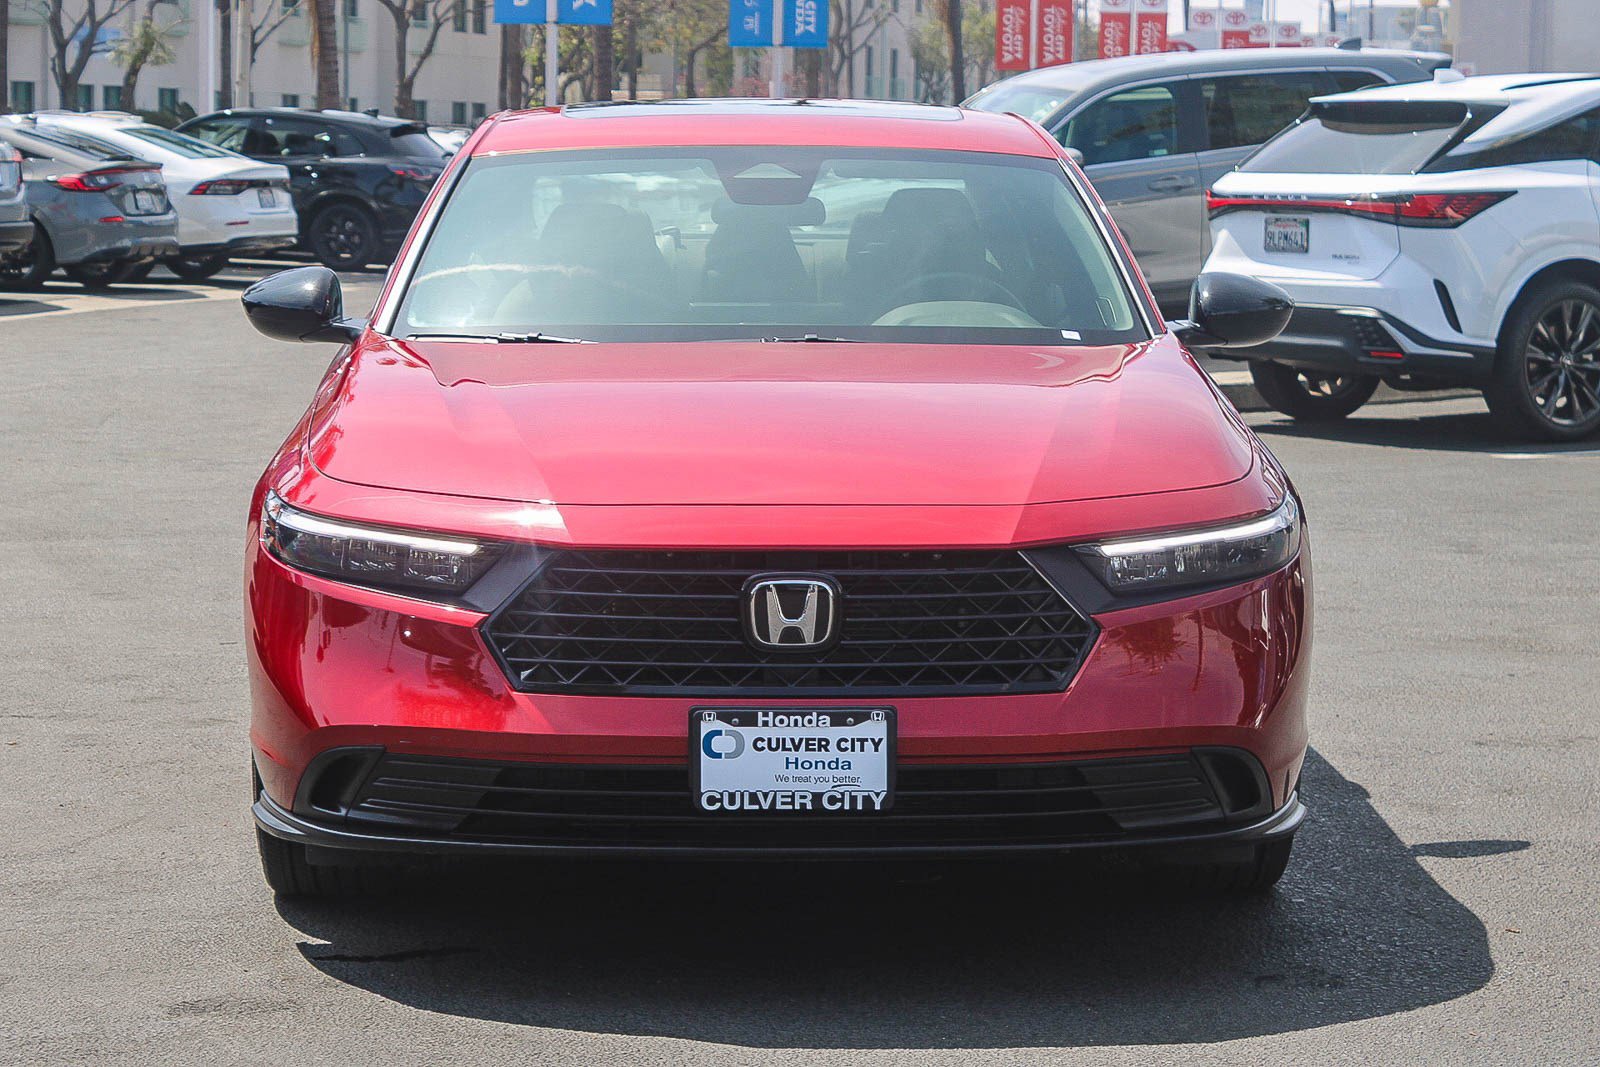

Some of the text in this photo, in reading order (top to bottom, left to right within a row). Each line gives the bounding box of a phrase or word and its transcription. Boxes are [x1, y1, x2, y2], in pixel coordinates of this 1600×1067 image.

[1002, 5, 1014, 64] TOYOTA
[1042, 5, 1055, 64] TOYOTA
[1103, 20, 1114, 57] TOYO
[1140, 20, 1151, 54] TOYO
[757, 711, 831, 728] Honda
[752, 736, 884, 753] CULVER CITY
[785, 757, 852, 771] Honda
[775, 774, 862, 786] We treat you better.
[700, 789, 887, 811] CULVER CITY
